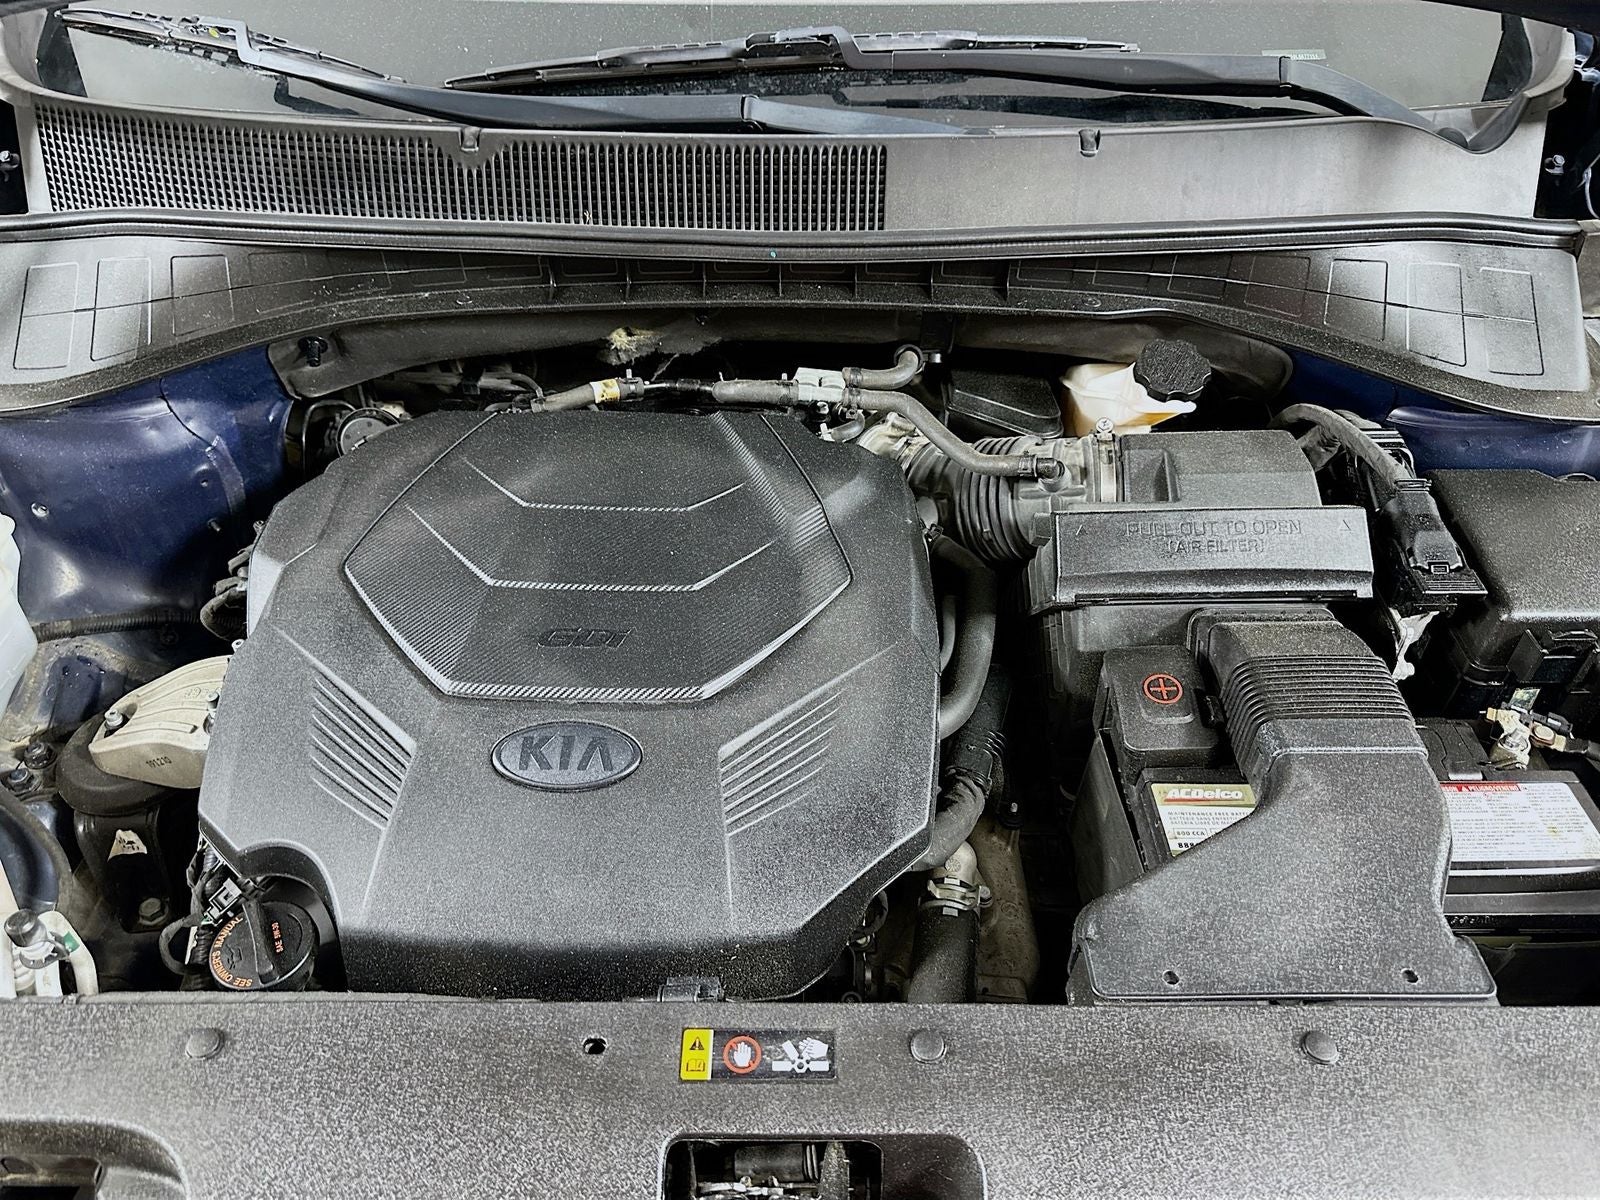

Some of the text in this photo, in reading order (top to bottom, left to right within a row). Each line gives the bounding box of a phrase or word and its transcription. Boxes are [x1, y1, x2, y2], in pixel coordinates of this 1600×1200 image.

[1179, 520, 1219, 536] OUT
[1223, 520, 1247, 536] TO
[1252, 519, 1302, 535] OPEN
[518, 734, 614, 772] KIA
[212, 916, 252, 987] SEE OWNER'S MANUAL
[274, 940, 284, 953] SAE
